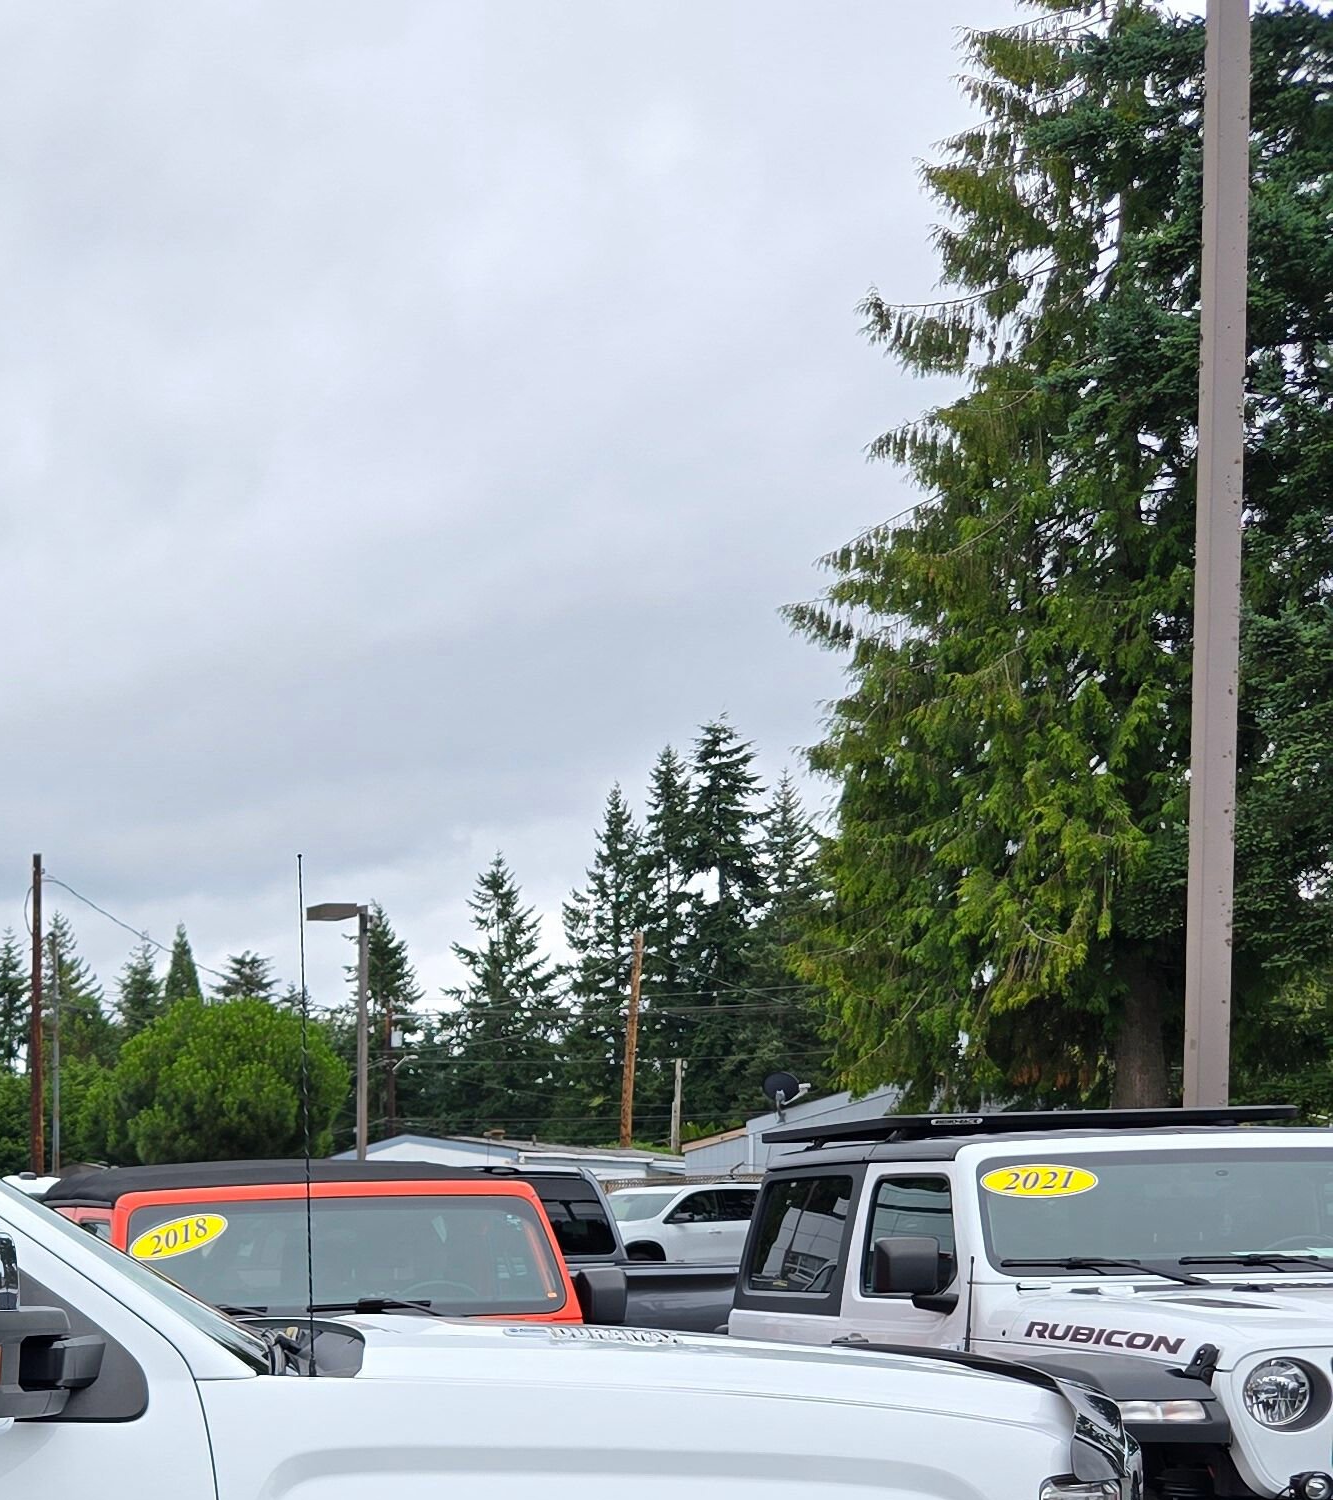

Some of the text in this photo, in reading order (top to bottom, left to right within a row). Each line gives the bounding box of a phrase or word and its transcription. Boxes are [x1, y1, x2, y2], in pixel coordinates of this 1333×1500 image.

[1002, 1170, 1075, 1191] 2021
[149, 1217, 208, 1256] 2018
[550, 1326, 682, 1347] DURAMAX
[1024, 1321, 1186, 1355] RUBICON
